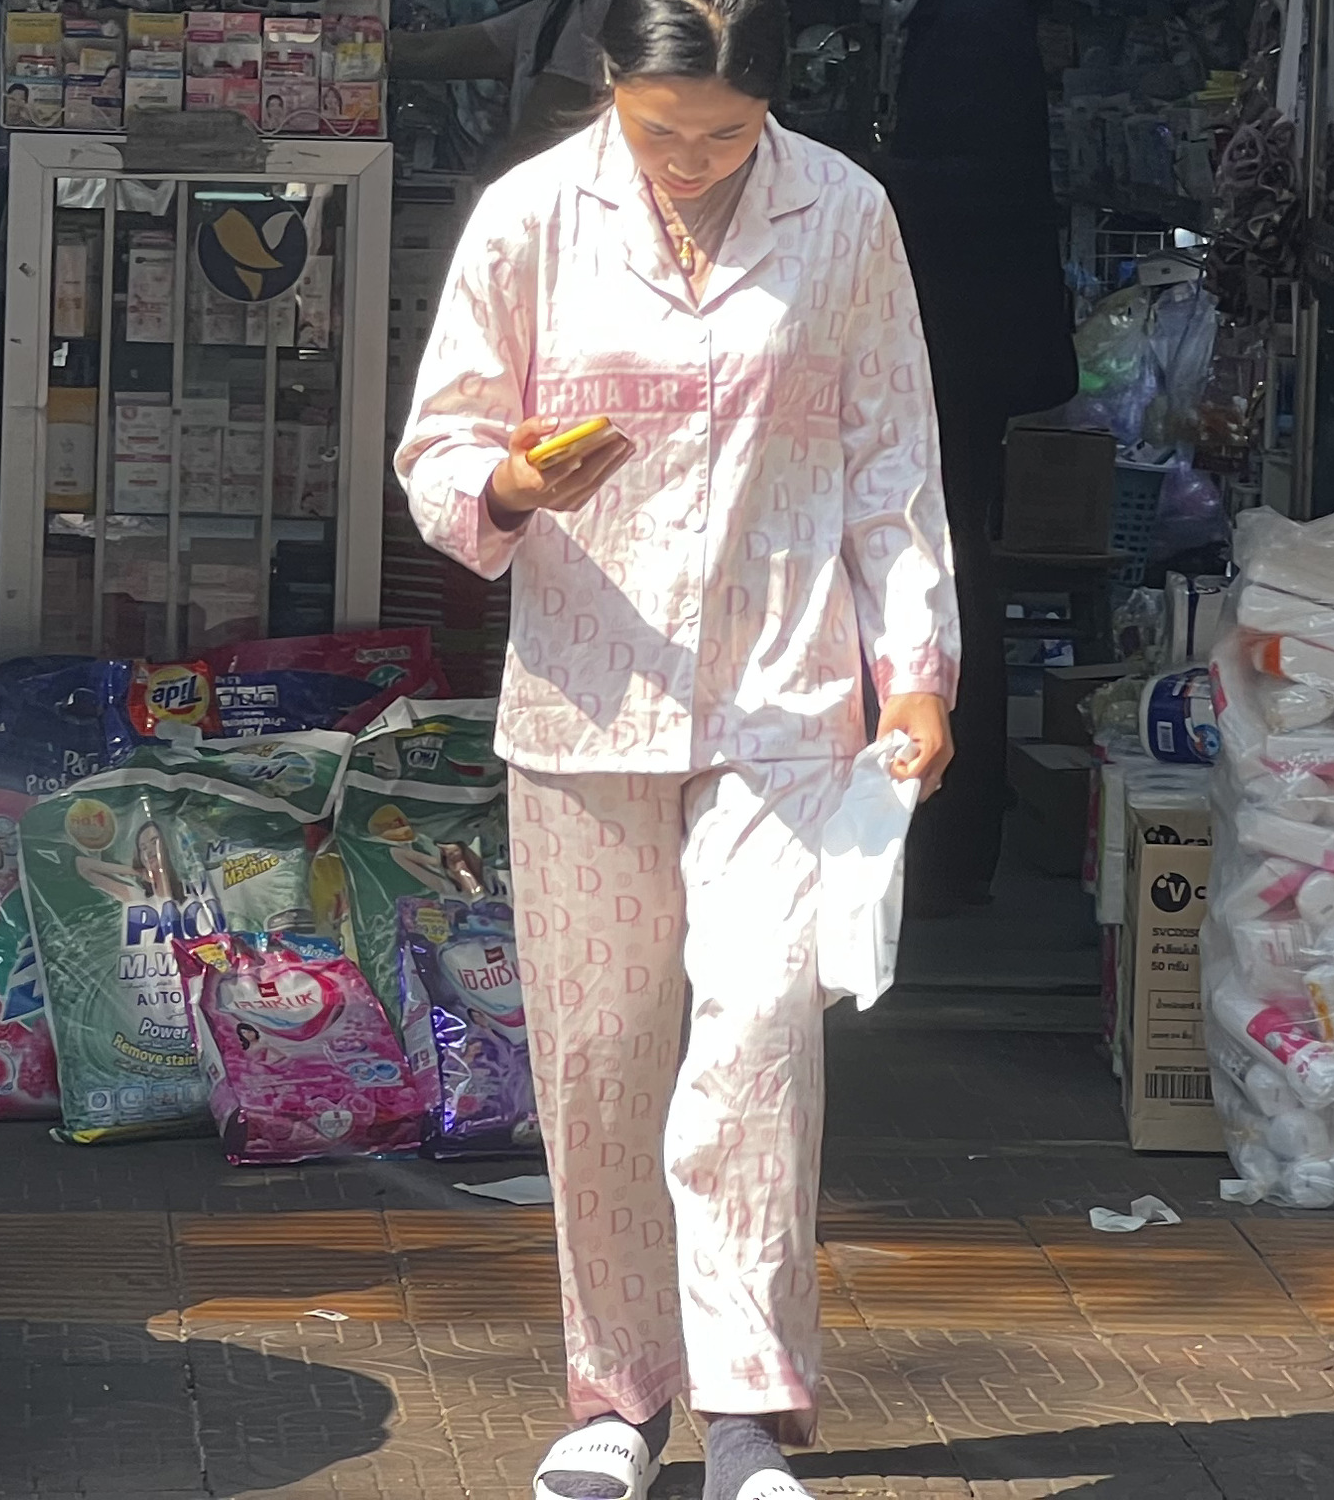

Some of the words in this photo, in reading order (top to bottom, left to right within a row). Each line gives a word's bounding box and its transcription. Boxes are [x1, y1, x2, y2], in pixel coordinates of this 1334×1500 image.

[151, 675, 203, 709] Tide
[223, 853, 257, 872] Magic
[223, 855, 279, 890] Machine
[1152, 962, 1165, 971] 50
[137, 991, 182, 1006] AUTO
[140, 1018, 188, 1040] Power
[113, 1033, 163, 1065] Remove
